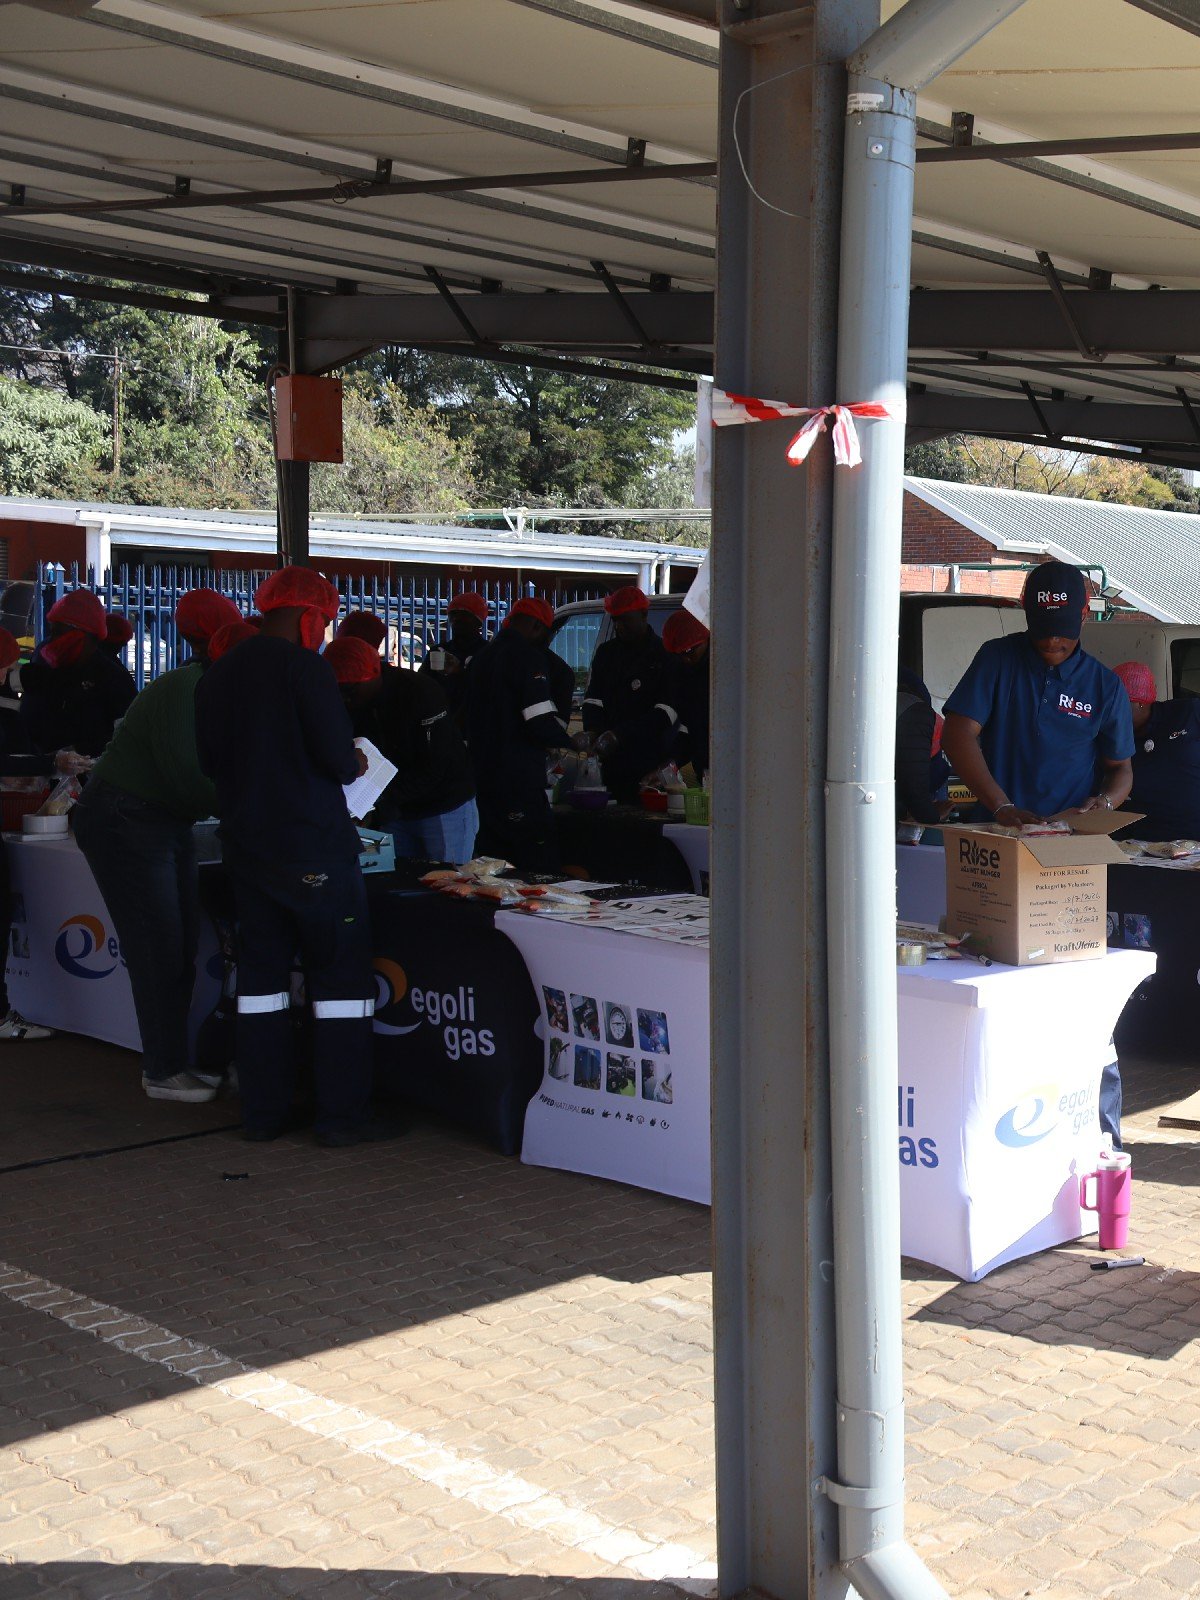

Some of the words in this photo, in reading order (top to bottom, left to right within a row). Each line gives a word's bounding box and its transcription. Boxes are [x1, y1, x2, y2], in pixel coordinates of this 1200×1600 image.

[411, 986, 475, 1025] egoli
[443, 1025, 496, 1061] gas
[539, 1093, 554, 1107] PIPED
[580, 1107, 595, 1115] GAS
[1058, 1080, 1095, 1116] egoli
[1073, 1105, 1096, 1135] gas
